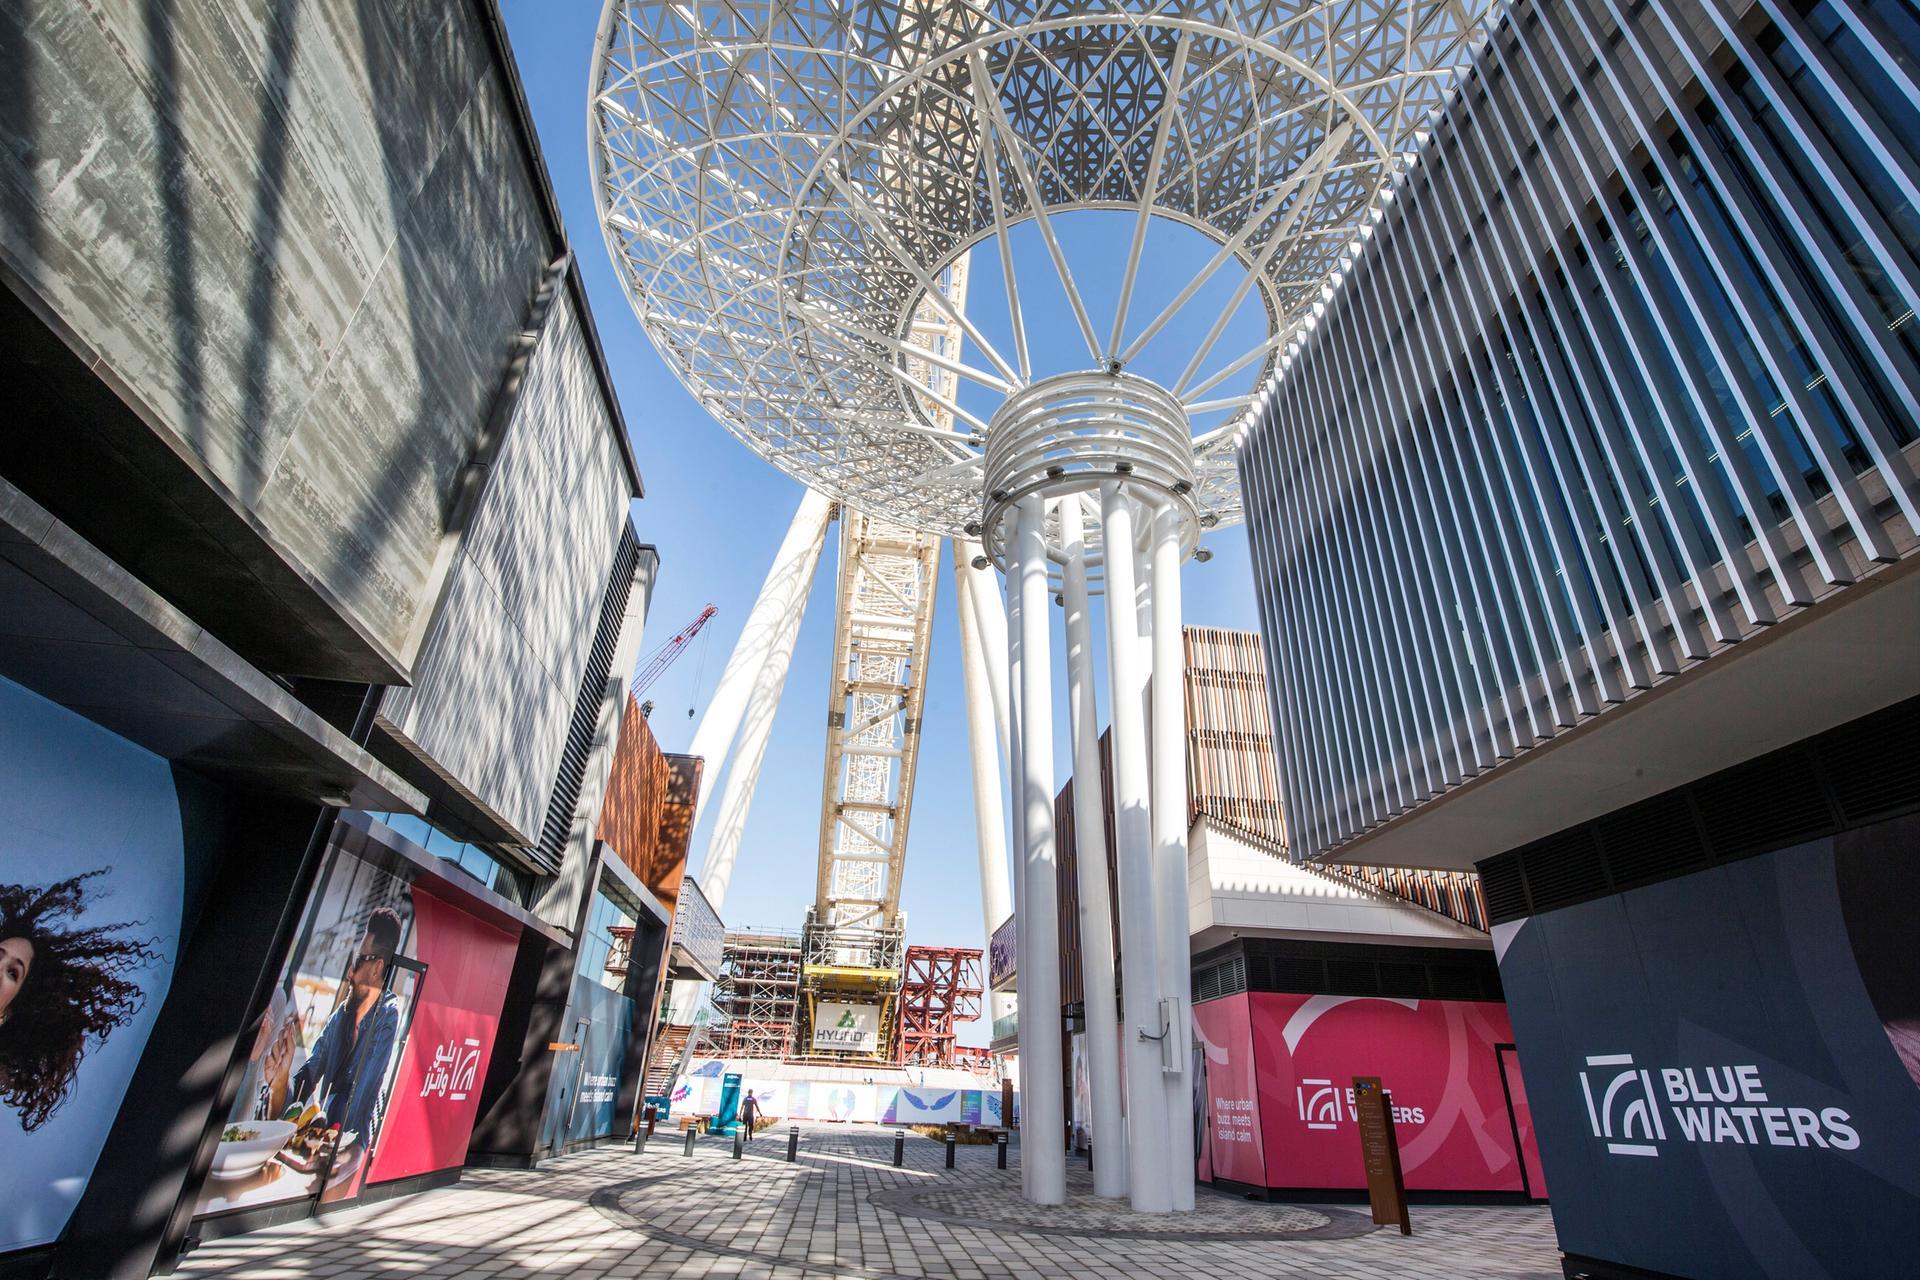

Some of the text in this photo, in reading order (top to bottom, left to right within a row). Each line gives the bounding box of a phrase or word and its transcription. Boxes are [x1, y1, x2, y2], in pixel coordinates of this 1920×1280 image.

[433, 1040, 457, 1069] بلو
[420, 1066, 449, 1097] واترز
[1661, 1065, 1768, 1103] BLUE
[1216, 1097, 1253, 1111] Where urban
[1348, 1105, 1425, 1124] WERS
[1217, 1112, 1251, 1126] buzz meets
[1672, 1106, 1861, 1150] WATERS
[1218, 1127, 1251, 1142] island calm
